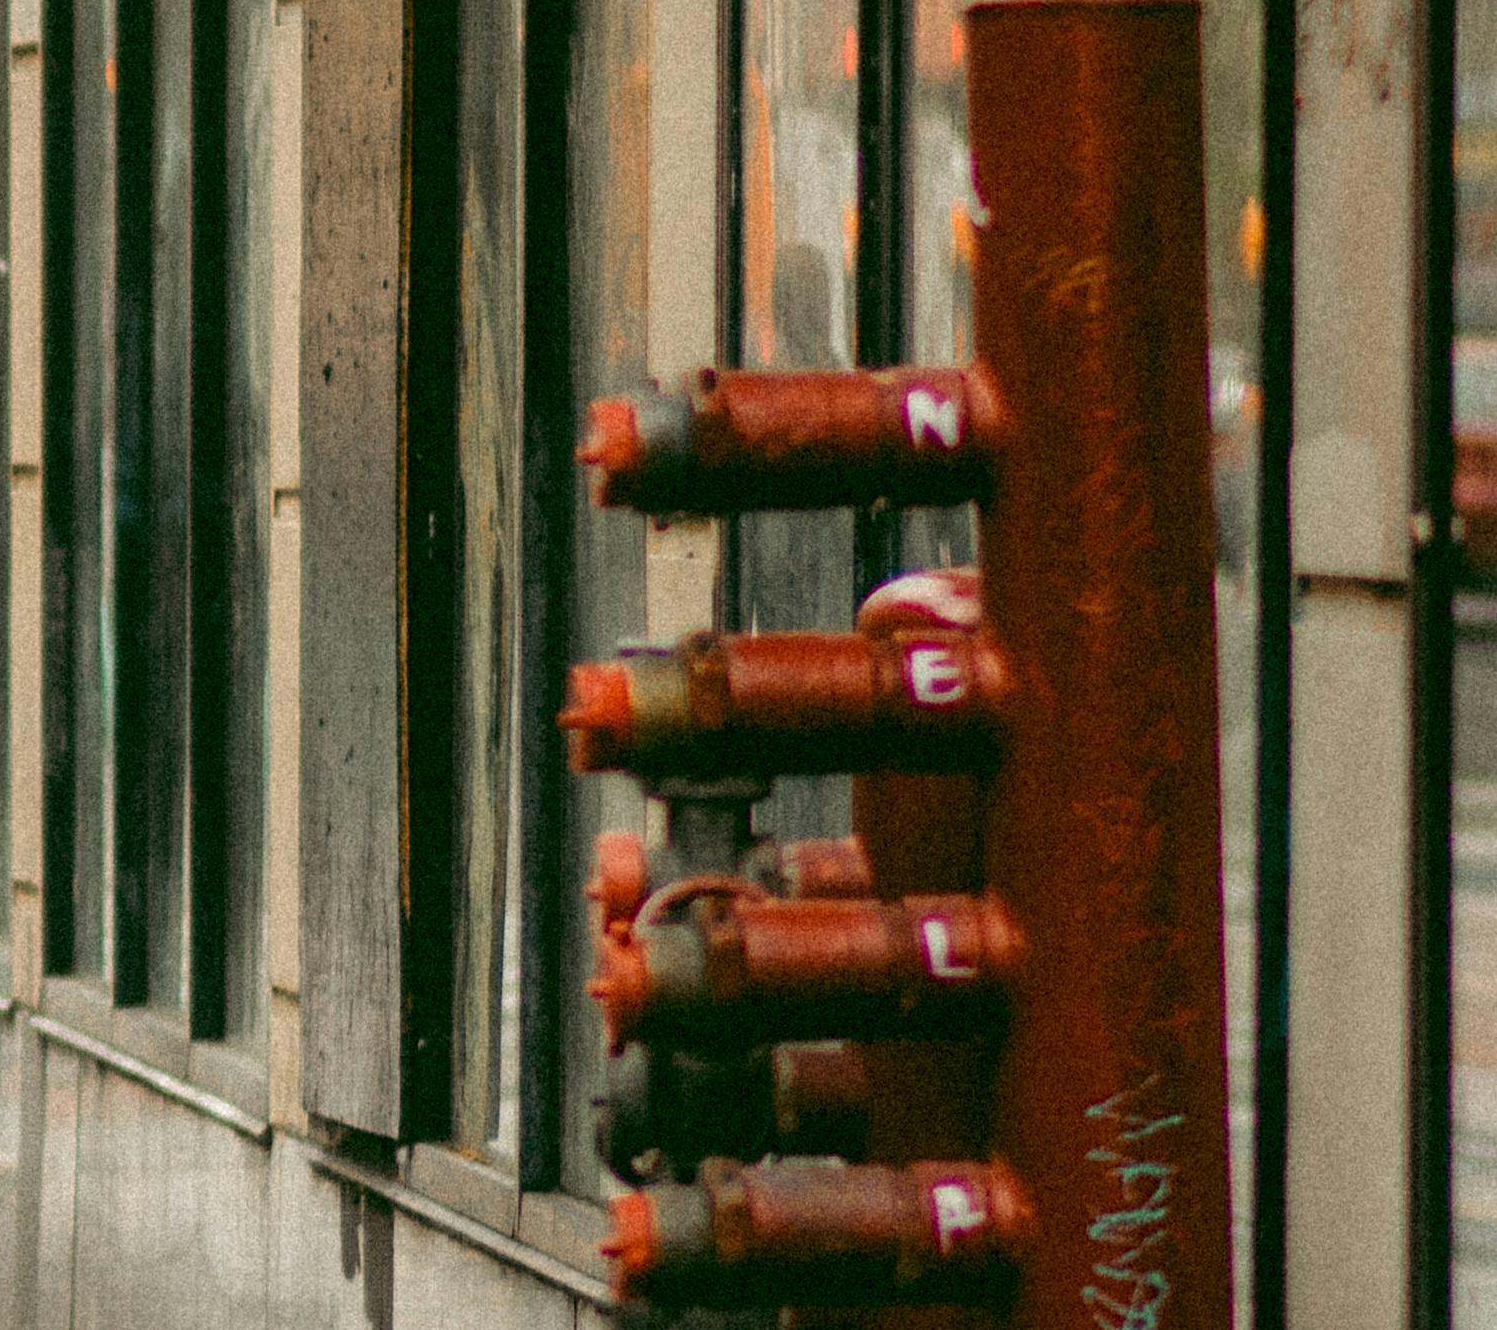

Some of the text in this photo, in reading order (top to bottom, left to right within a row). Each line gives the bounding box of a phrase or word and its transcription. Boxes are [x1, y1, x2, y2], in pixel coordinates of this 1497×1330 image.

[906, 389, 960, 450] N
[910, 649, 964, 704] E
[922, 919, 975, 978] L
